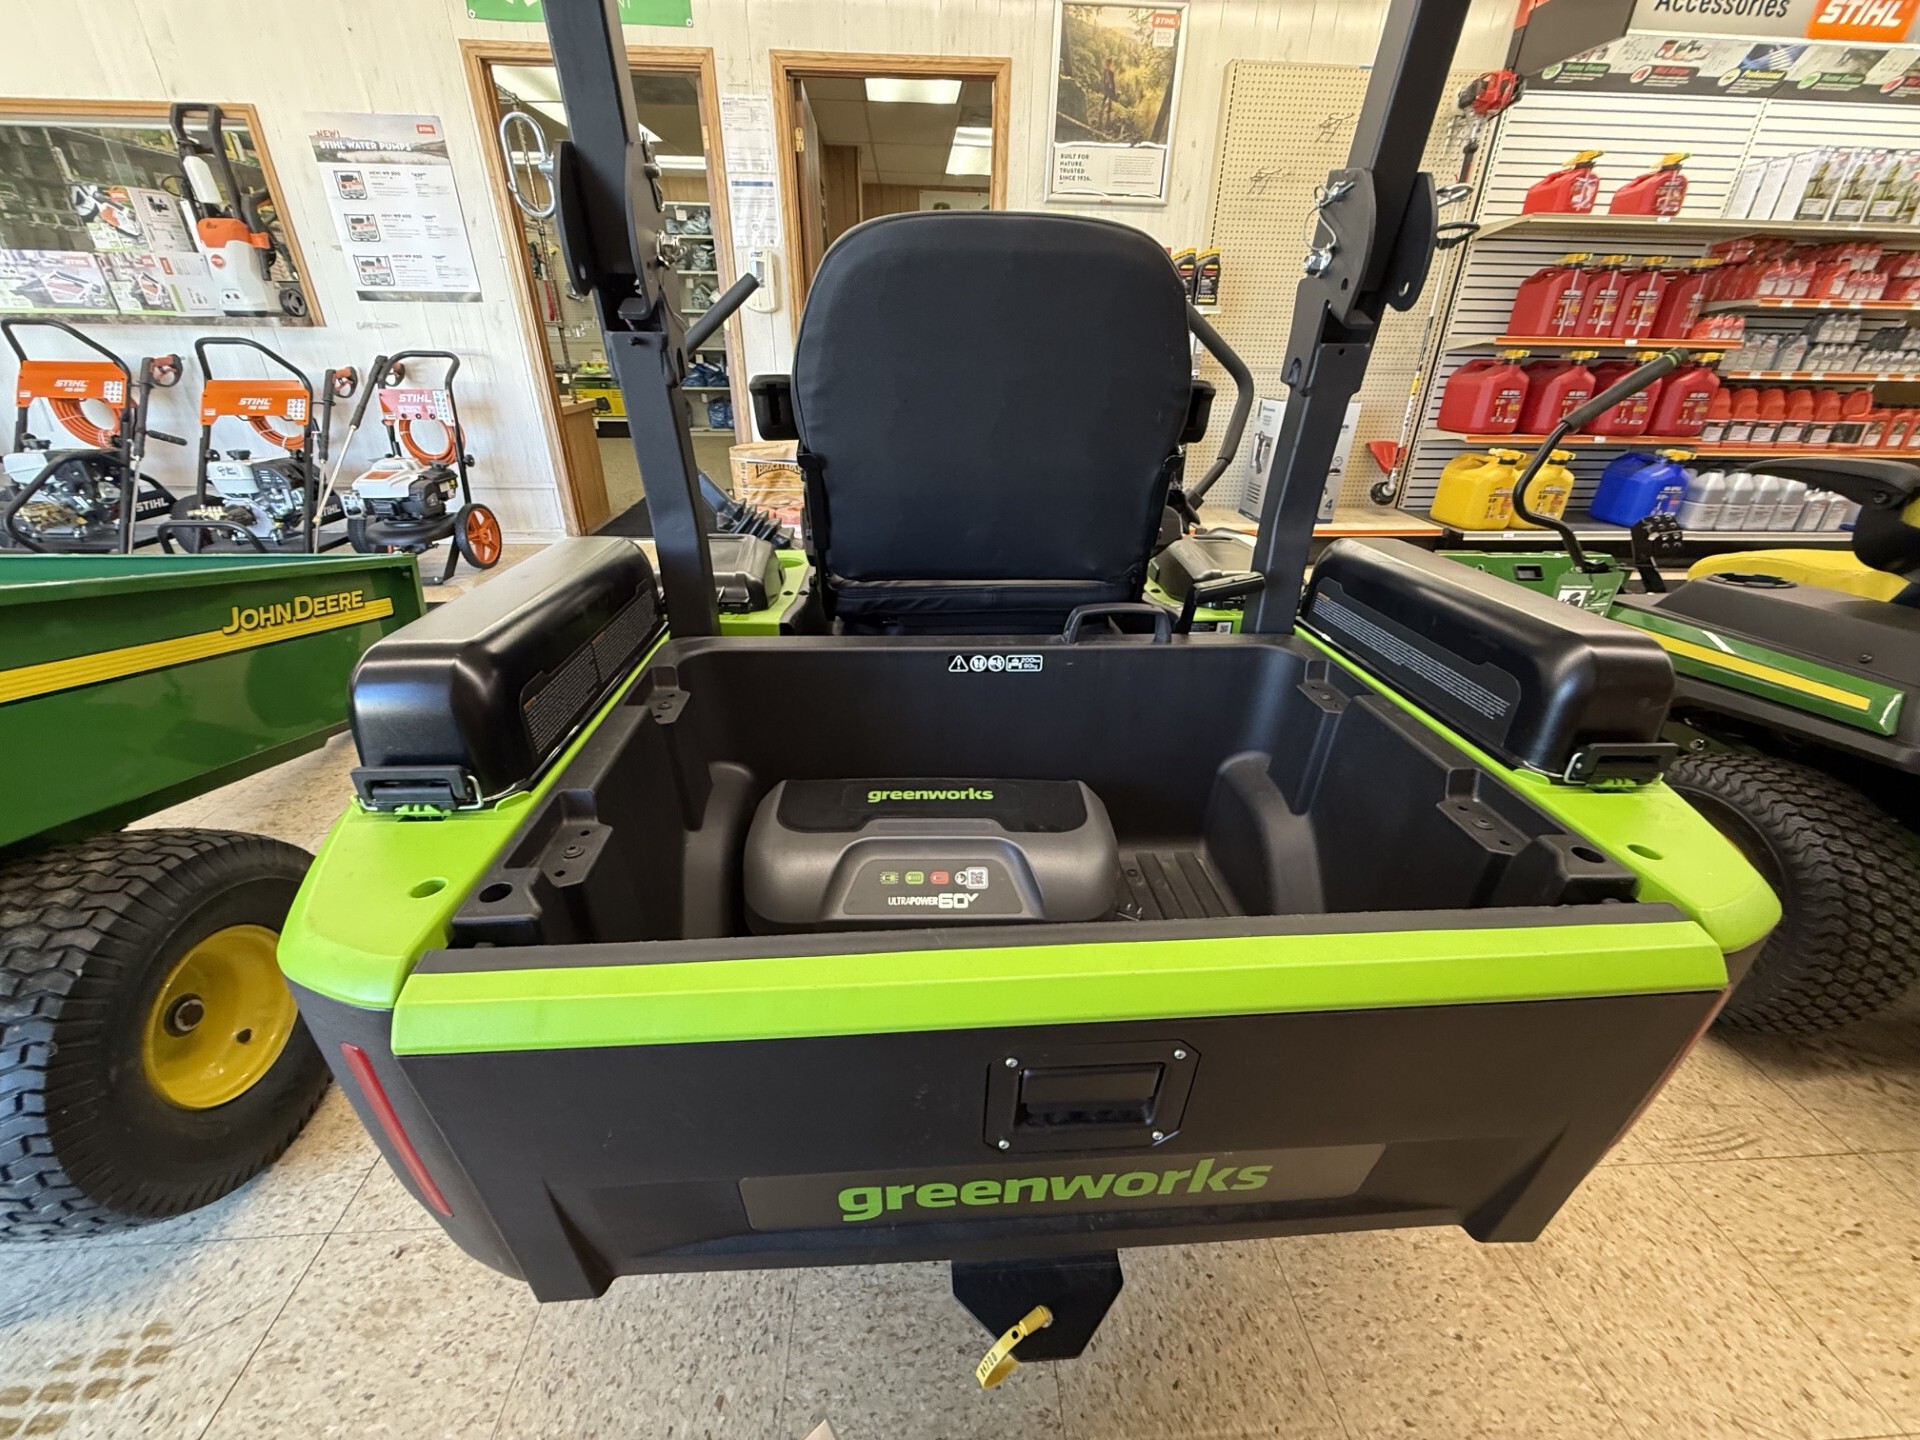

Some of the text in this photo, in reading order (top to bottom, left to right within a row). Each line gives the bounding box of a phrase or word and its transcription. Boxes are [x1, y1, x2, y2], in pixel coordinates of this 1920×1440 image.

[1816, 0, 1903, 27] STIHL
[1154, 16, 1177, 26] STIHL
[316, 129, 341, 139] NEW!
[318, 140, 412, 152] STIHL WATER PUMPS
[64, 257, 89, 266] STIHL
[54, 379, 89, 388] STIHL
[238, 397, 271, 407] STIHL
[398, 393, 432, 403] STIHL
[135, 497, 170, 513] STIHL
[222, 590, 364, 634] JOHN DEERE
[867, 787, 994, 803] greenworks
[837, 1157, 1275, 1222] greenworks
